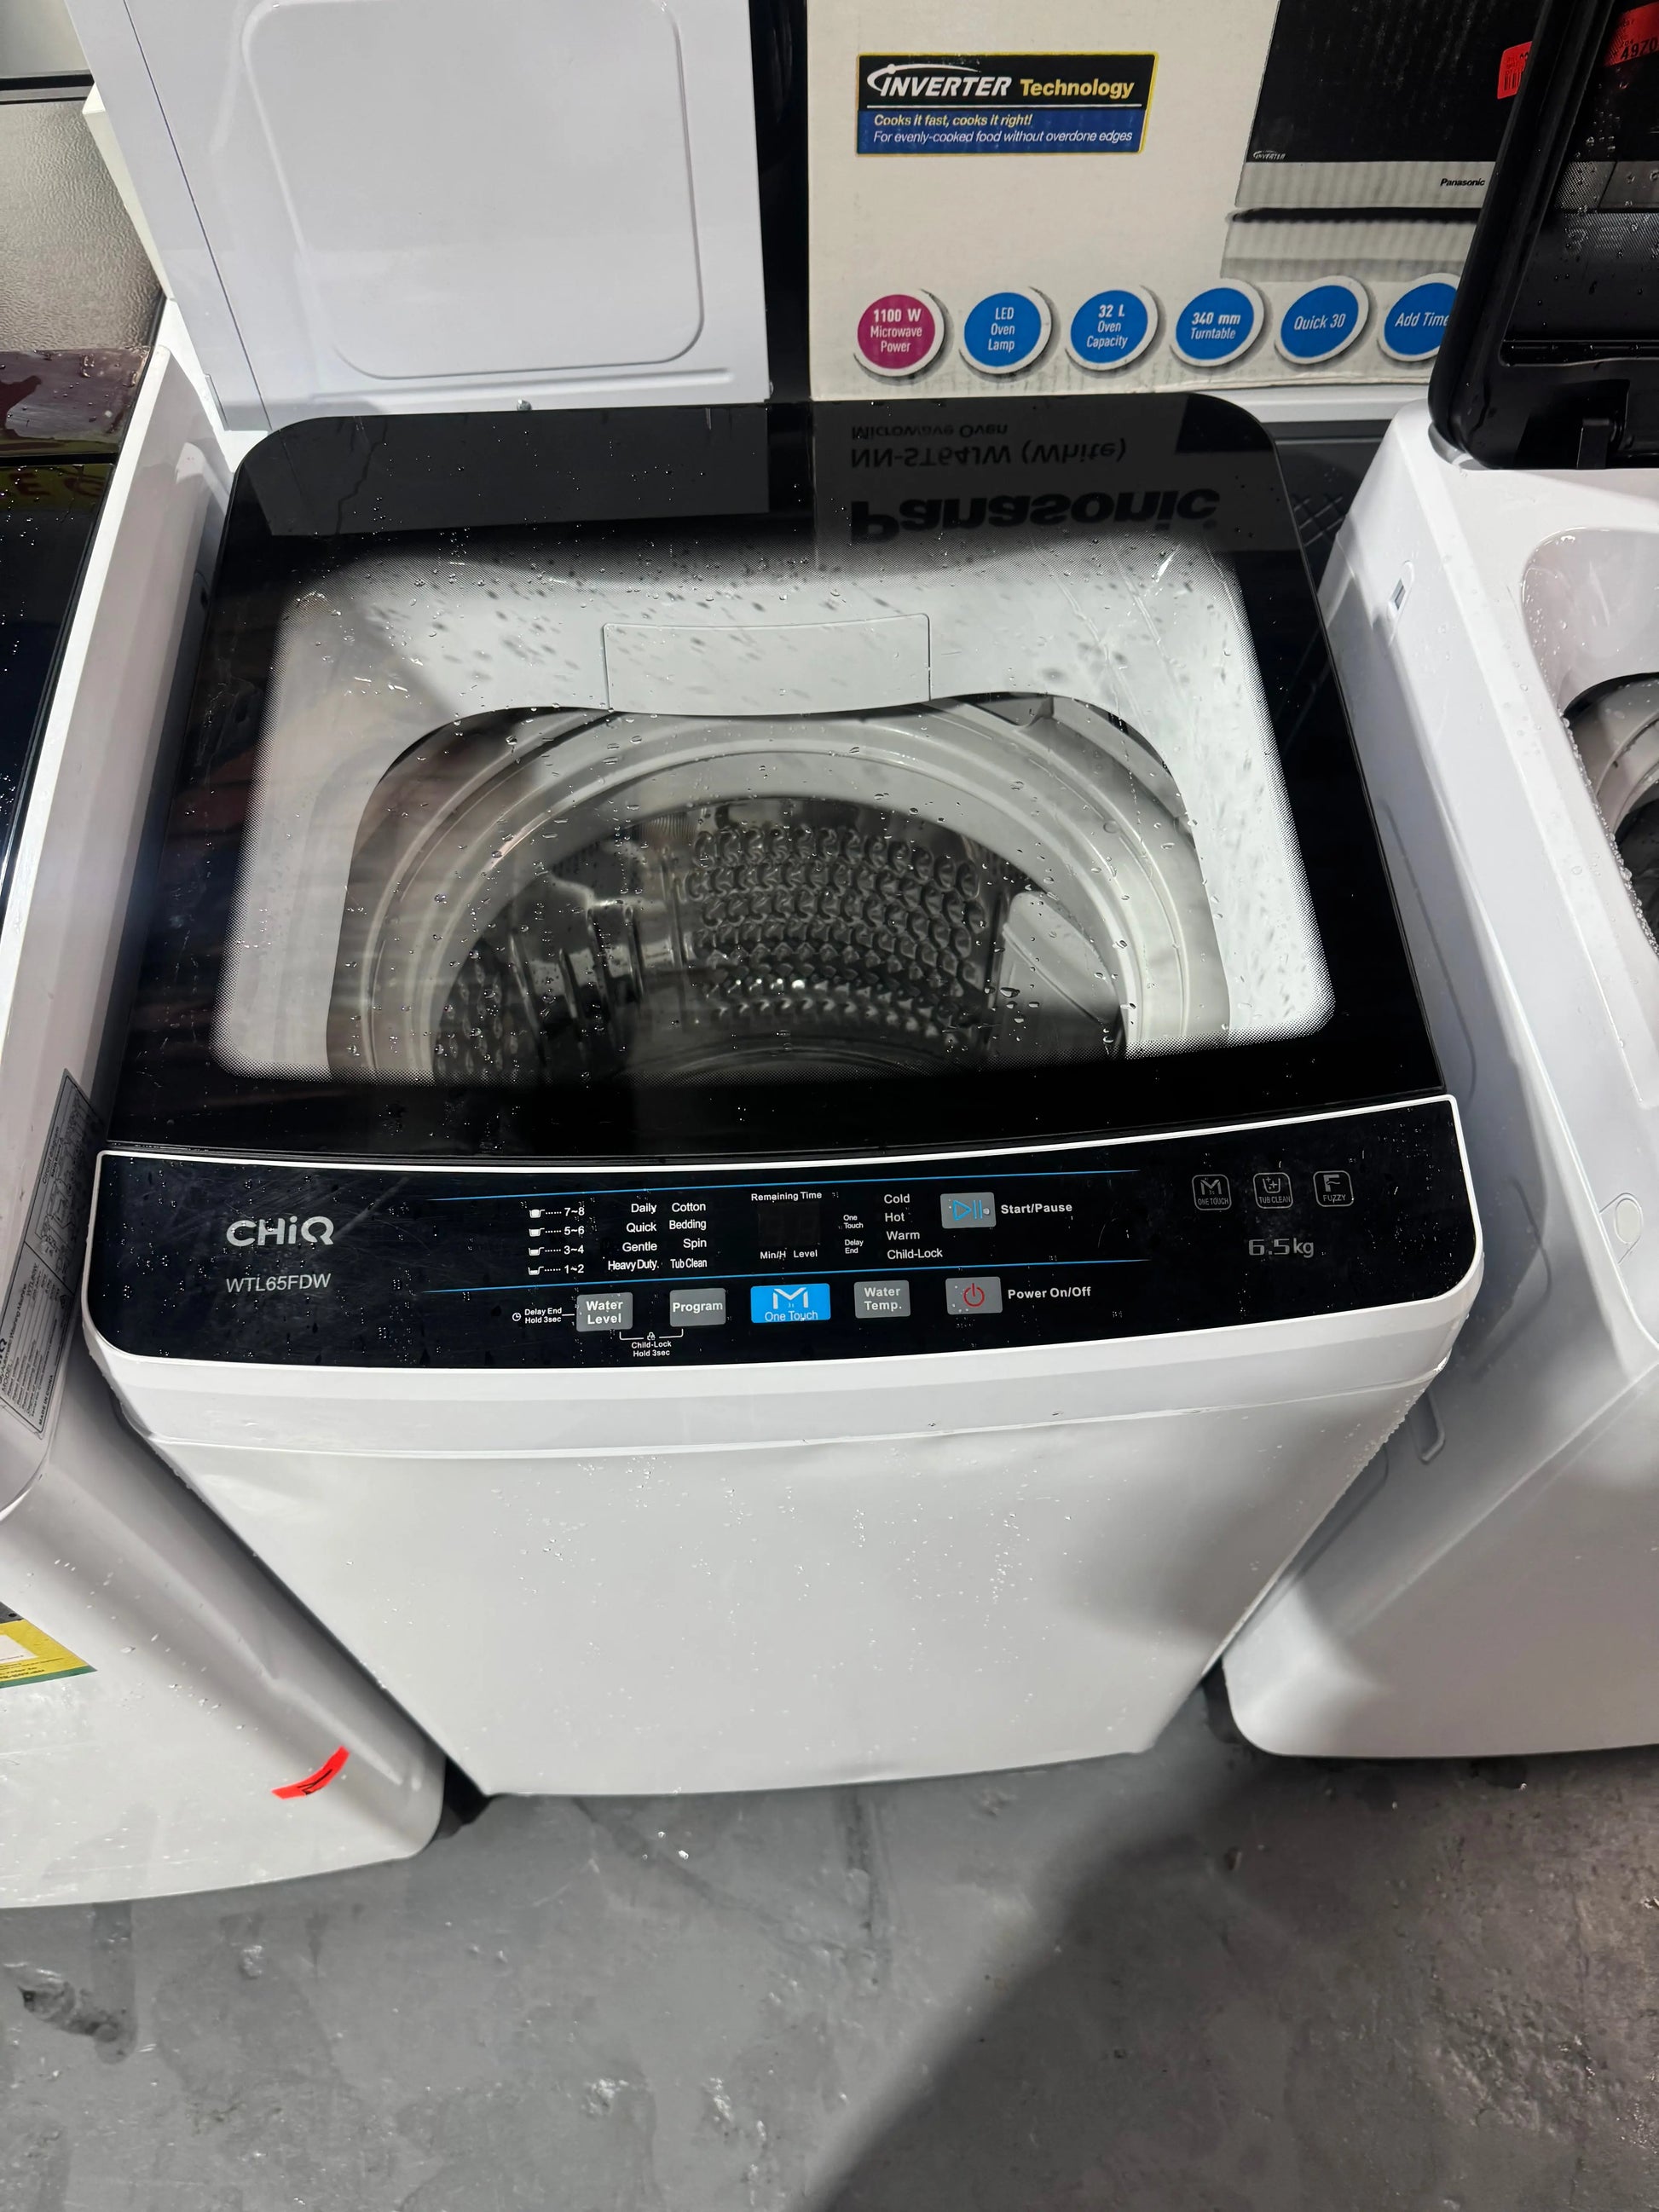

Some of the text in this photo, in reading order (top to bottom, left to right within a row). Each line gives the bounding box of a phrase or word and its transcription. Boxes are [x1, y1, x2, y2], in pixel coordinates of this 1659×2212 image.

[867, 64, 1135, 99] INVERTER Technology
[874, 113, 1033, 127] Cooks it fast, cooks it right!
[873, 130, 1133, 144] For evenly-cooked food without overdone edges
[1440, 177, 1486, 187] Panasonic
[873, 308, 922, 322] 1100 W
[995, 308, 1014, 321] LED
[1098, 303, 1125, 318] 32 L
[1192, 312, 1240, 325] 340 mm
[1293, 314, 1346, 331] Quick 30
[1395, 312, 1450, 327] Add Time
[870, 325, 922, 338] Microwave
[991, 323, 1015, 336] Oven
[1097, 321, 1122, 333] Oven
[1191, 327, 1236, 340] Turntable
[881, 341, 910, 353] Power
[988, 338, 1014, 352] Lamp
[1086, 336, 1128, 349] Capacity
[751, 1193, 799, 1203] Remaining
[884, 1194, 910, 1204] Cold
[1210, 1197, 1229, 1205] TOUCH
[1271, 1195, 1291, 1204] CLEAN
[564, 1207, 585, 1216] 7~8
[631, 1203, 657, 1214] Daily
[672, 1202, 707, 1212] Cotton
[1000, 1204, 1073, 1214] Start/Pause
[885, 1212, 905, 1222] Hot
[564, 1226, 585, 1235] 5~6
[626, 1222, 657, 1233] Quick
[669, 1220, 707, 1231] Bedding
[887, 1232, 920, 1241] Warm
[622, 1241, 657, 1252] Gentle
[683, 1239, 707, 1250] Spin
[845, 1239, 864, 1247] Delay
[1248, 1238, 1314, 1258] 6.5kg
[564, 1245, 585, 1255] 3~4
[793, 1250, 818, 1258] Level
[887, 1248, 943, 1260] Child-Lock
[564, 1264, 585, 1273] 1~2
[608, 1260, 636, 1272] Heavy
[670, 1258, 708, 1268] Tub Clean
[226, 1273, 332, 1293] WTL65FDW
[864, 1287, 900, 1297] Water
[1008, 1286, 1091, 1299] Power On/Off
[586, 1300, 623, 1312] Water
[673, 1302, 723, 1314] Program
[864, 1301, 902, 1312] Temp.
[524, 1308, 546, 1318] Delay
[764, 1310, 818, 1322] One Touch
[587, 1313, 621, 1325] Level
[632, 1340, 672, 1349] Child-Lock
[652, 1349, 671, 1357] 3sec
